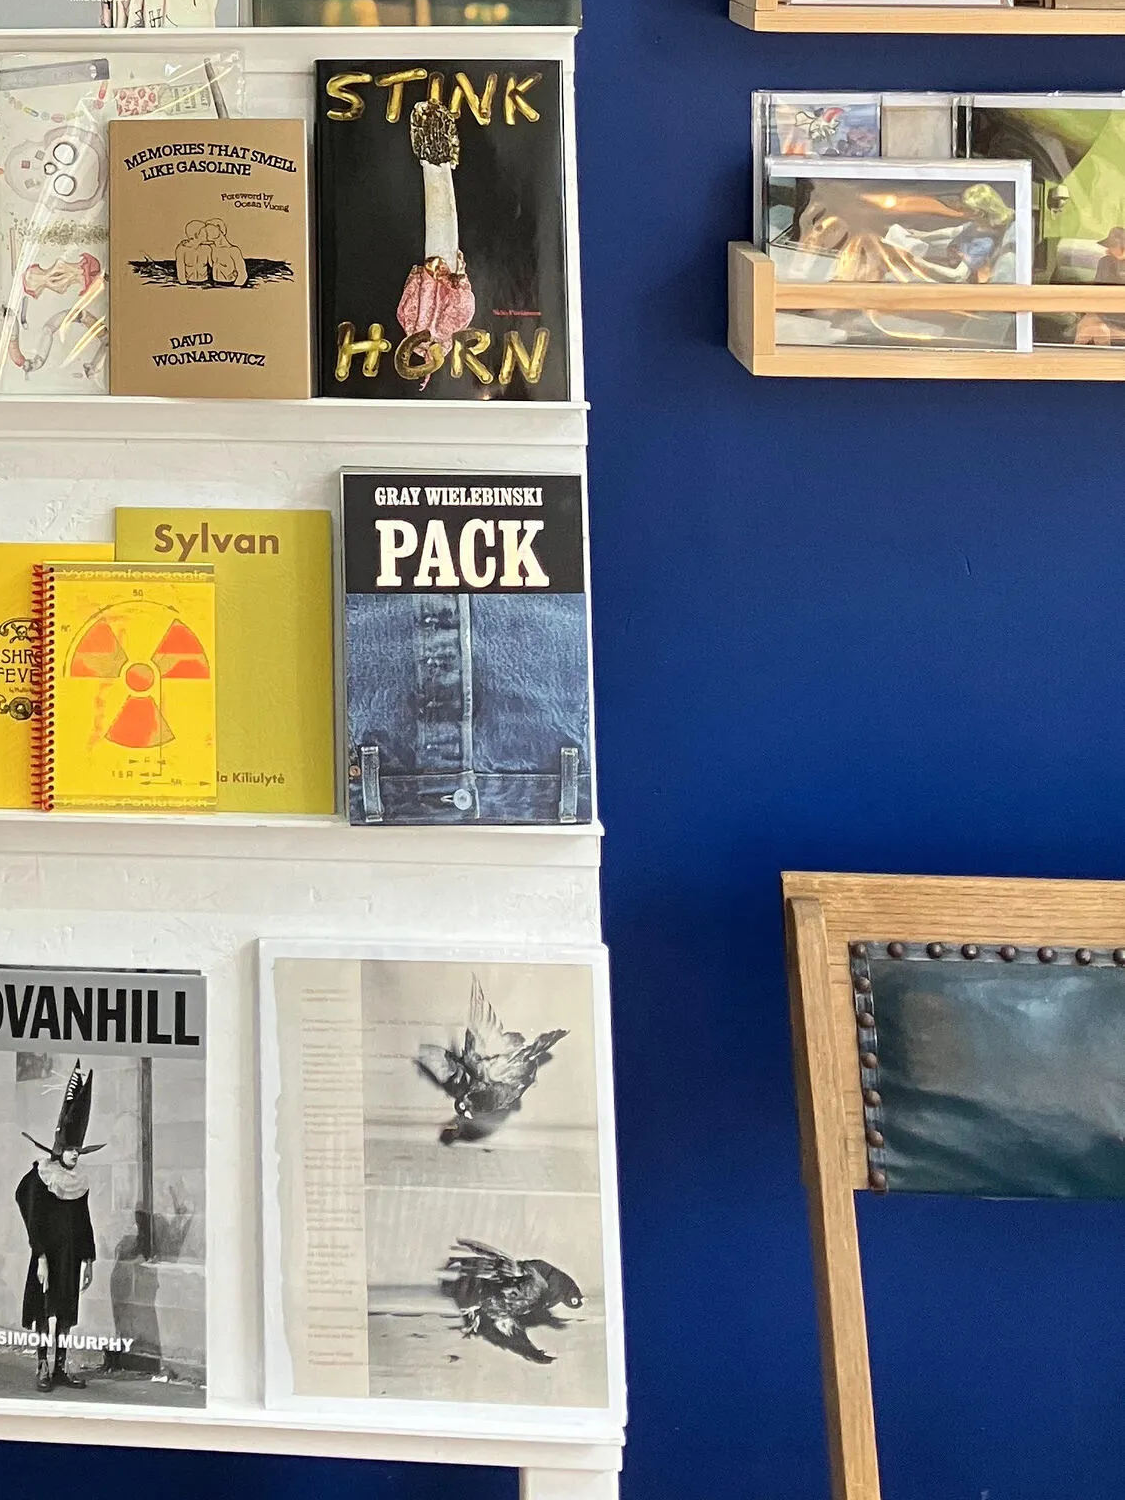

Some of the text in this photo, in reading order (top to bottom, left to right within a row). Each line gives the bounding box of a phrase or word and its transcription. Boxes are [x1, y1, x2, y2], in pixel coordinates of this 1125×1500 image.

[325, 67, 544, 126] STINK
[124, 143, 297, 172] MEMORIES THAT SMELL
[141, 160, 251, 181] LIKE GASOLINE
[221, 193, 261, 201] Foreword
[264, 202, 289, 212] Vuong
[170, 333, 214, 350] DAVID
[151, 351, 266, 370] WOJNAROWICZ
[334, 321, 550, 385] HORN
[374, 487, 543, 507] GRAY WIELEBINSKI
[153, 521, 281, 563] Sylvan
[374, 518, 549, 589] PACK
[57, 1335, 134, 1353] MURPHY
